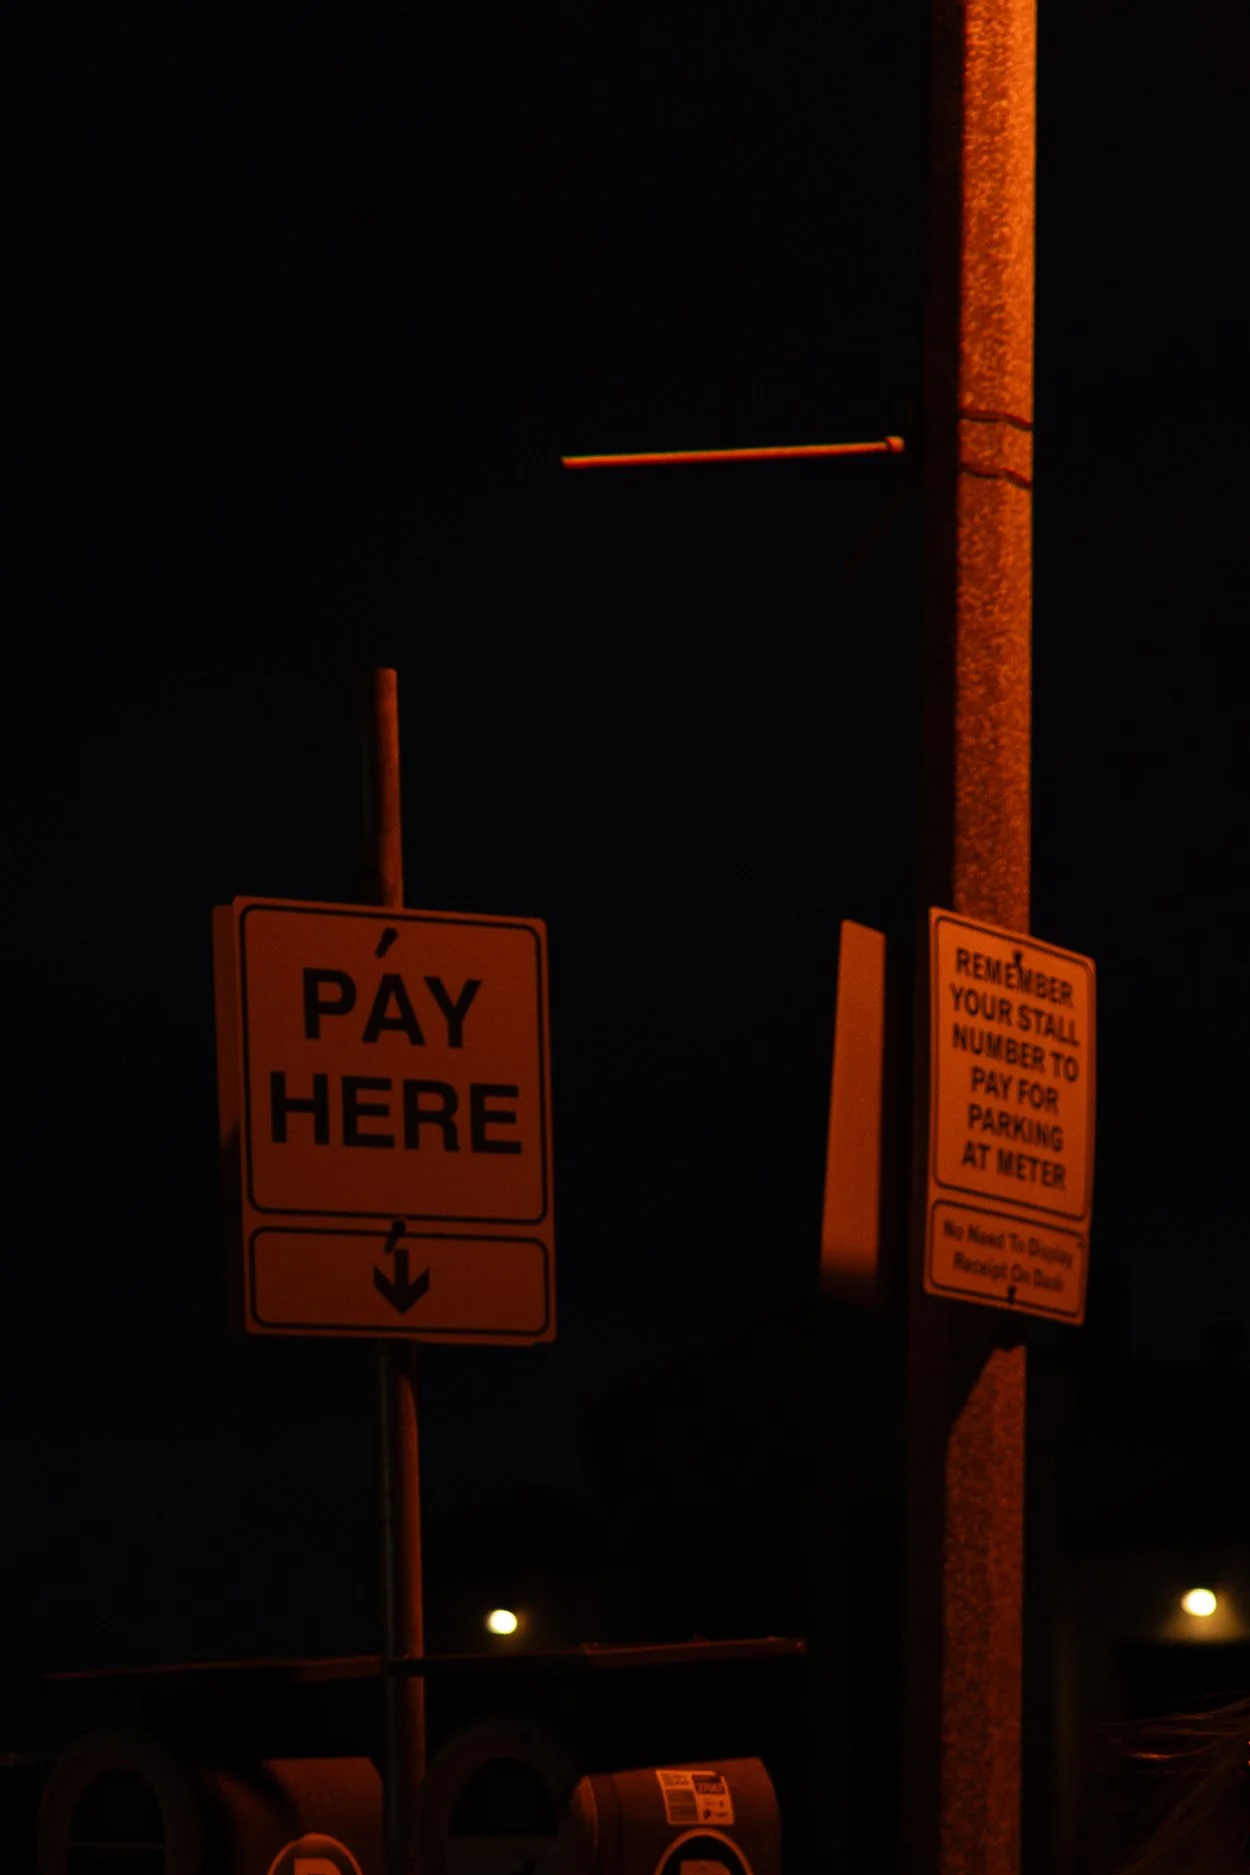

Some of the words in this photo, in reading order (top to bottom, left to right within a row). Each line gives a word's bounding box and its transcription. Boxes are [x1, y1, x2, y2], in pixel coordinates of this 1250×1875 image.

[956, 947, 1074, 1008] REMEMBER
[303, 967, 482, 1049] PAY
[950, 984, 1013, 1028] YOUR
[1018, 1004, 1080, 1048] STALL
[952, 1023, 1045, 1073] NUMBER
[1050, 1052, 1080, 1083] TO
[270, 1071, 522, 1154] HERE
[971, 1066, 1012, 1101] PAY
[1018, 1079, 1060, 1117] FOR
[968, 1103, 1064, 1153] PARKING
[962, 1140, 992, 1171] AT
[996, 1148, 1066, 1191] METER
[943, 1219, 964, 1240] No
[1006, 1233, 1026, 1253] To
[1010, 1263, 1031, 1284] On
